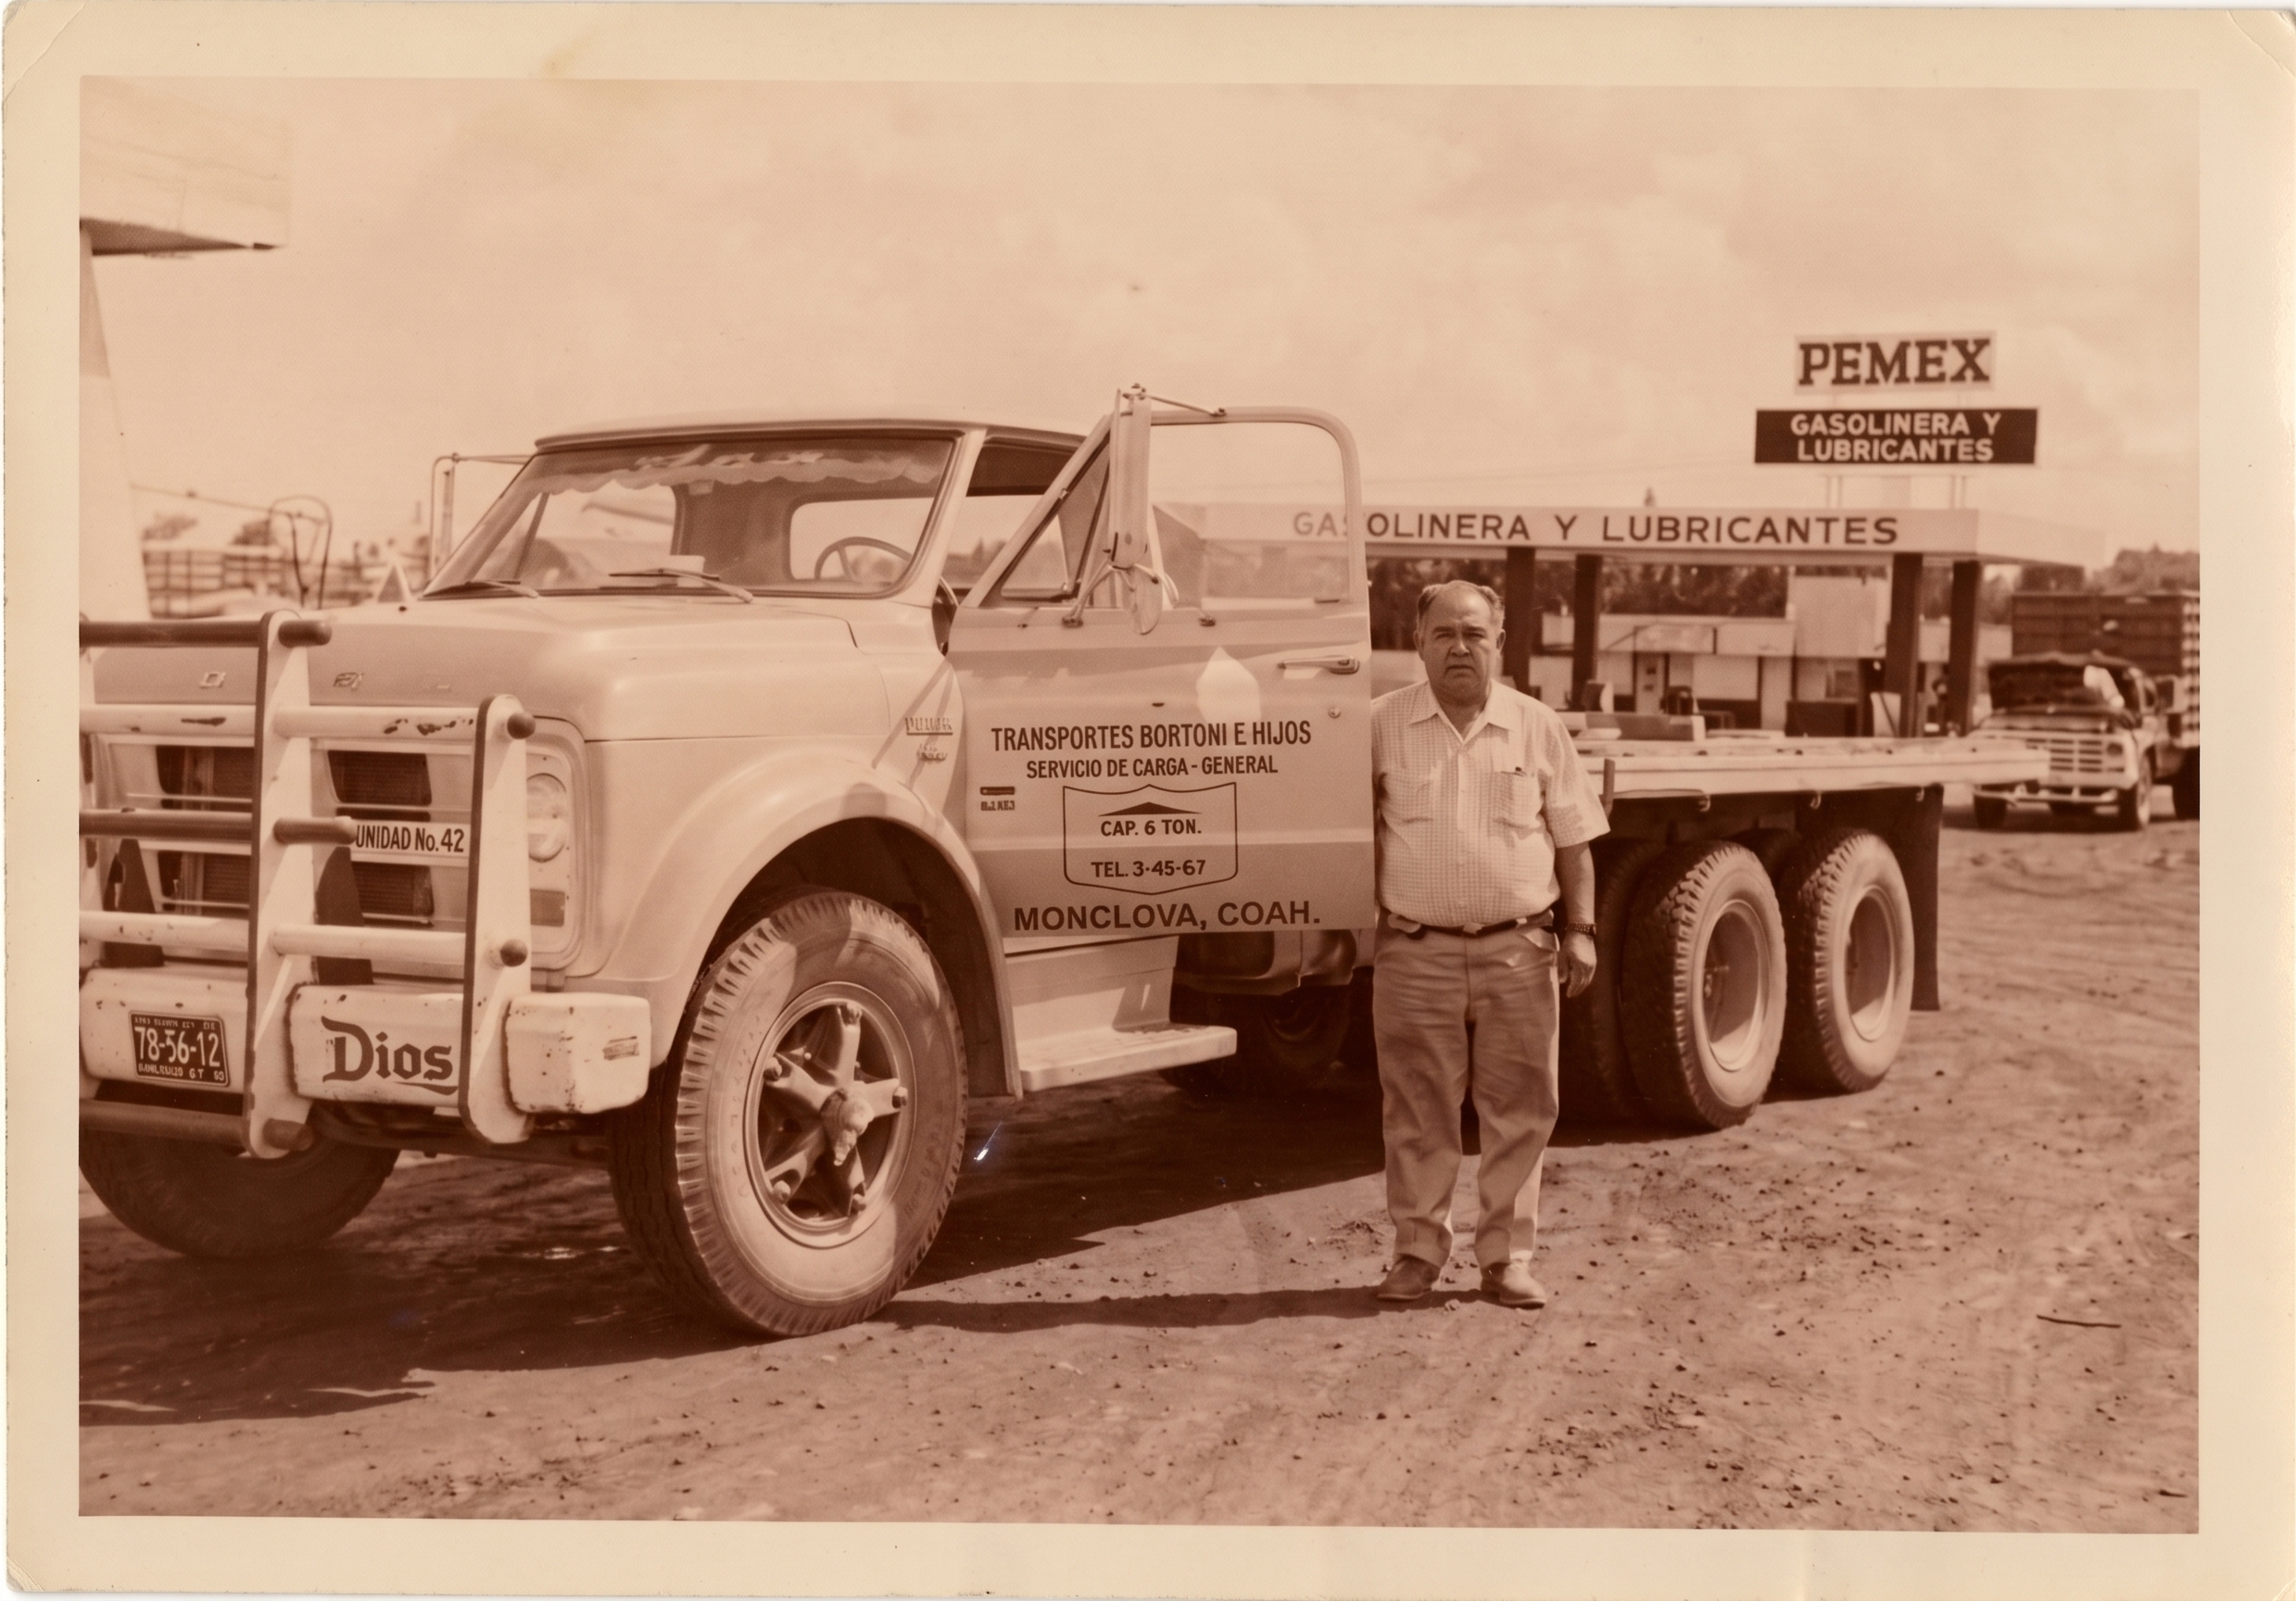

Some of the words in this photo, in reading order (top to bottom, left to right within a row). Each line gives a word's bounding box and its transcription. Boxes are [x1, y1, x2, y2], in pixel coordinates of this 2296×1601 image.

[1798, 339, 1990, 385] PEMEX
[1790, 412, 1970, 435] GASOLINERA
[1983, 411, 2001, 435] Y
[1798, 438, 1993, 461] LUBRICANTES
[1293, 511, 1531, 540] GAOLINERA
[1555, 513, 1577, 541] Y
[1602, 515, 1898, 545] LUBRICANTES
[990, 725, 1134, 751] TRANSPORTES
[1140, 723, 1228, 749] BORTONI
[1234, 722, 1247, 746] E
[1253, 720, 1312, 746] HIJOS
[1026, 759, 1103, 779] SERVICIO
[1106, 758, 1129, 777] DE
[356, 825, 411, 851] UNIDAD
[1100, 821, 1139, 837] CAP.
[1143, 820, 1156, 836] 6
[1161, 819, 1203, 835] TON.
[1091, 861, 1129, 878] TEL.
[1014, 903, 1207, 931] MONCLOVA,
[1217, 900, 1320, 927] COAH.
[133, 1026, 221, 1067] 78-56-12
[321, 1015, 454, 1083] Dios
